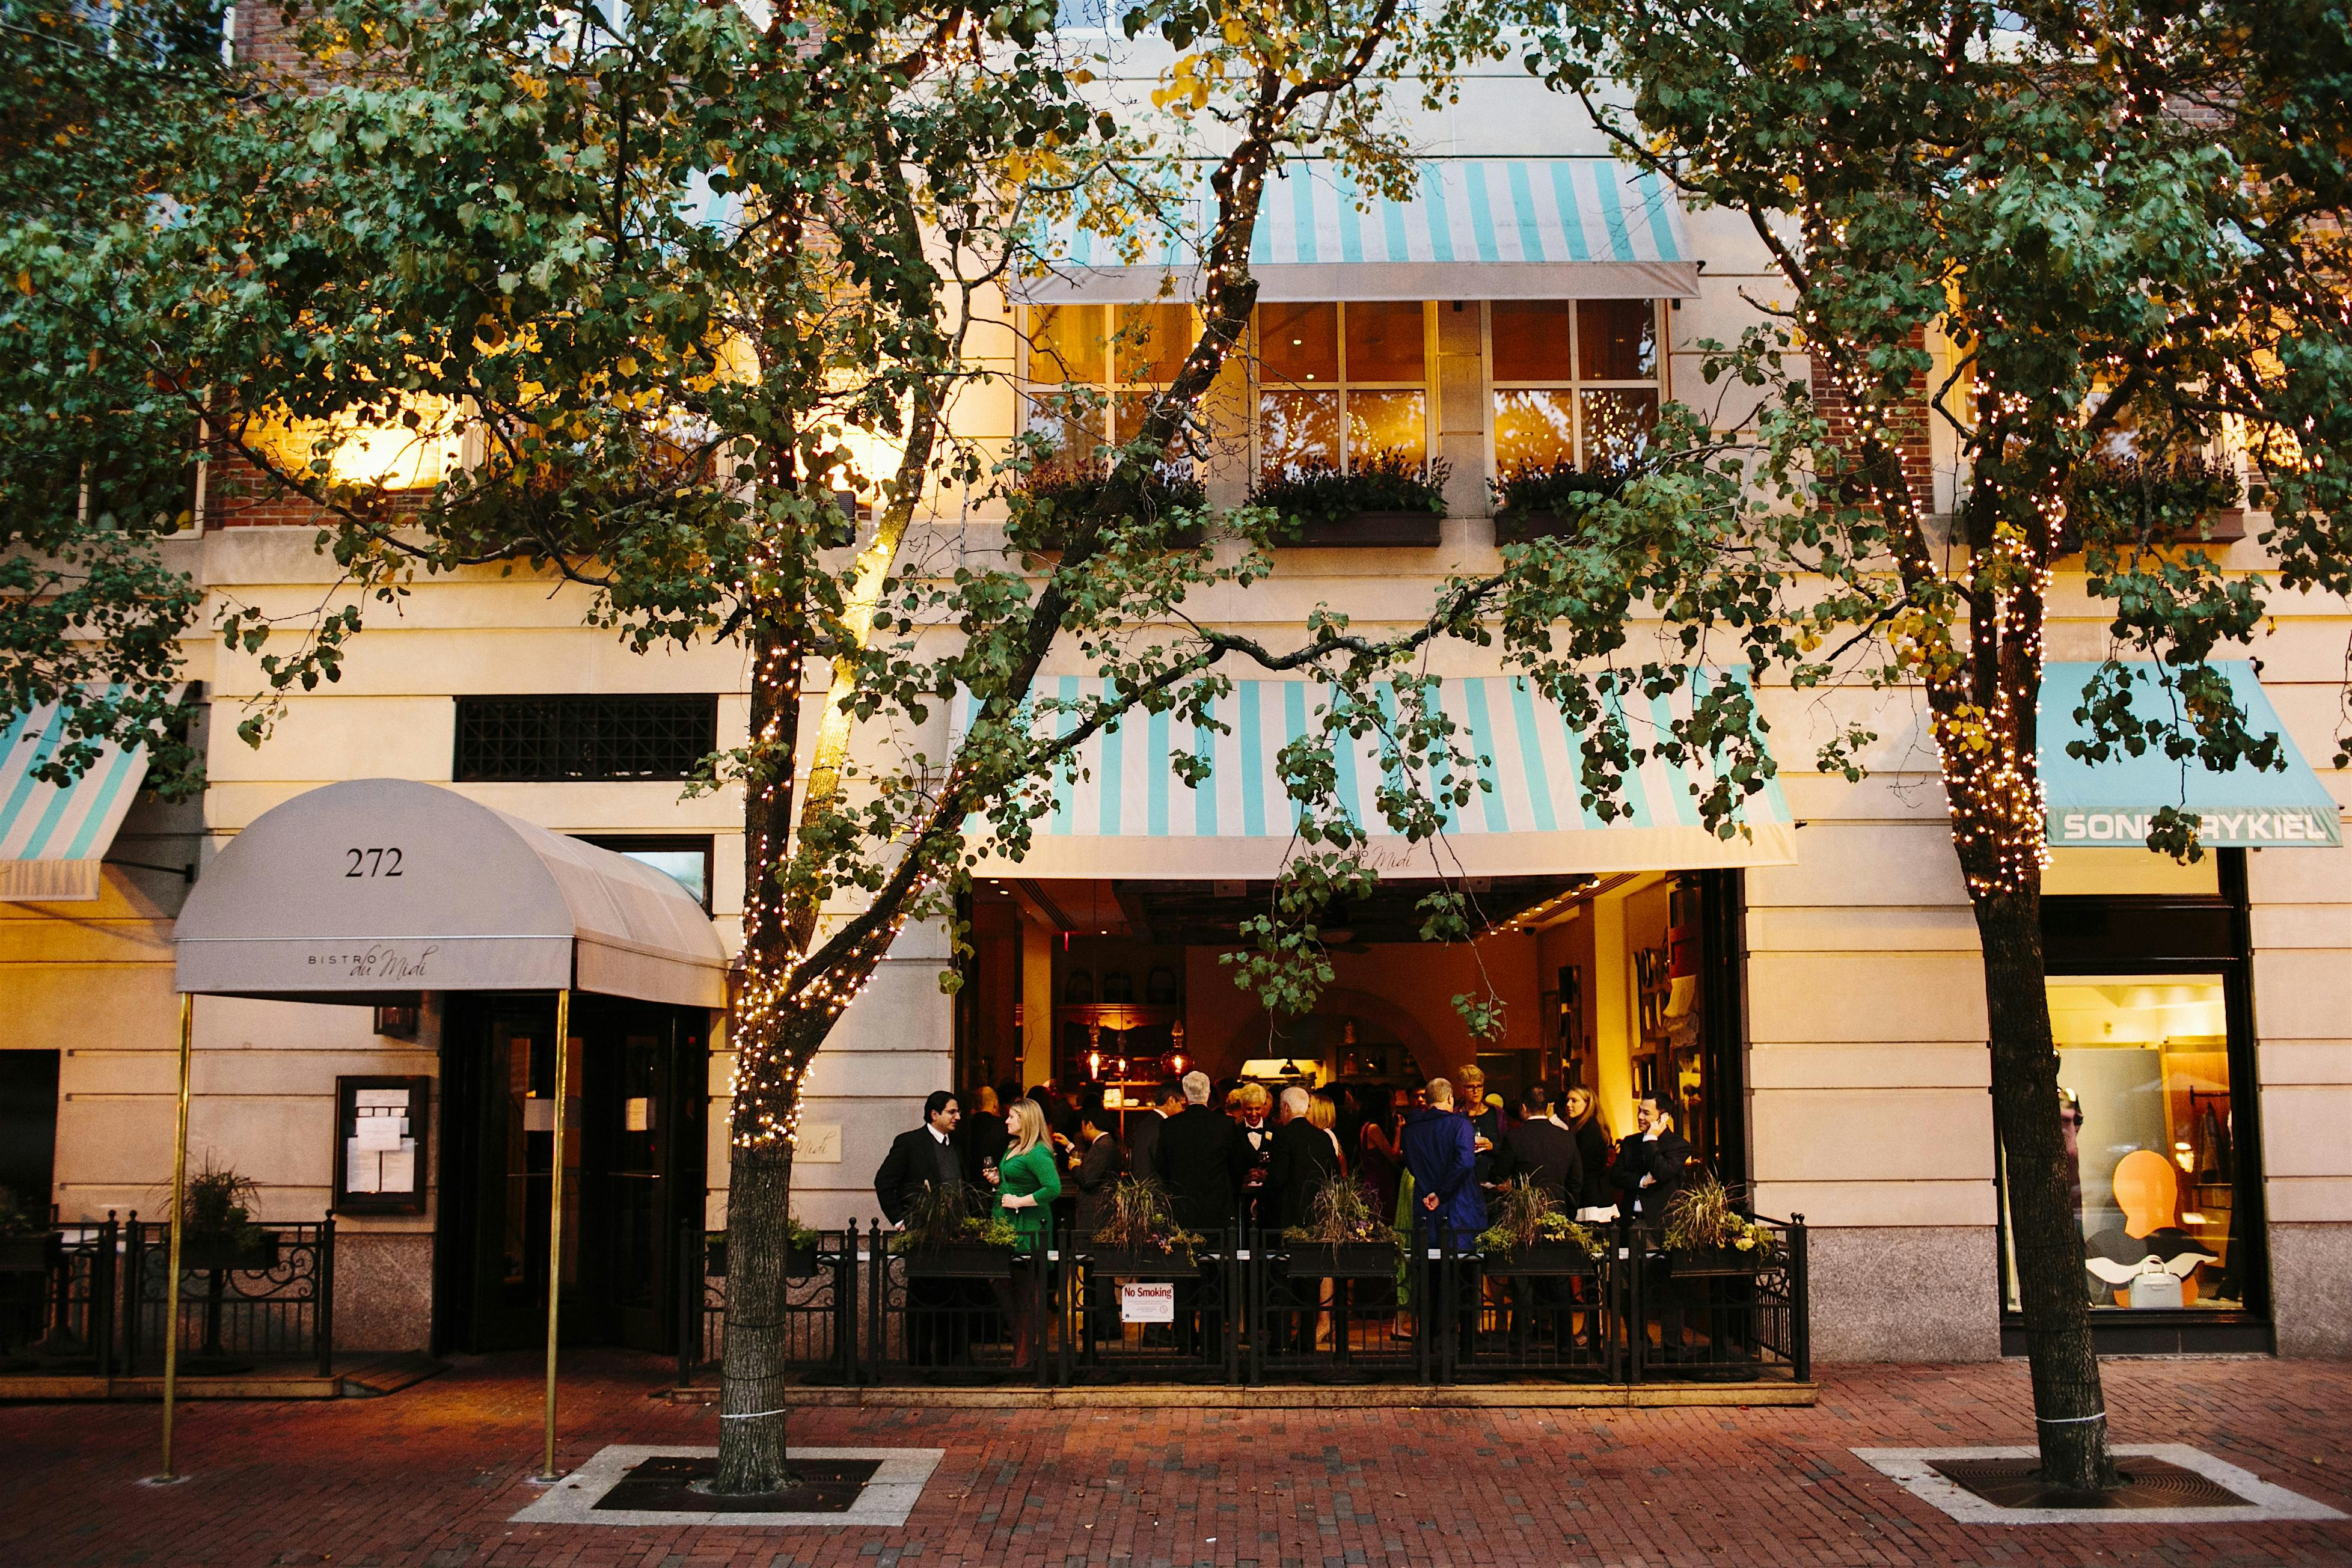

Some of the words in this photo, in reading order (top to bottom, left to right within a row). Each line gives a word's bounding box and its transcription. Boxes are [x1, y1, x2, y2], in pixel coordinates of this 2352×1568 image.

[2064, 813, 2175, 839] SONI
[2196, 813, 2327, 839] RYKIEL
[345, 847, 403, 877] 272
[1373, 842, 1421, 871] Midi
[308, 955, 376, 965] BISTRO
[350, 945, 381, 976] du
[379, 945, 438, 981] Midi
[1124, 1287, 1135, 1297] No
[1138, 1287, 1172, 1299] Smoking
